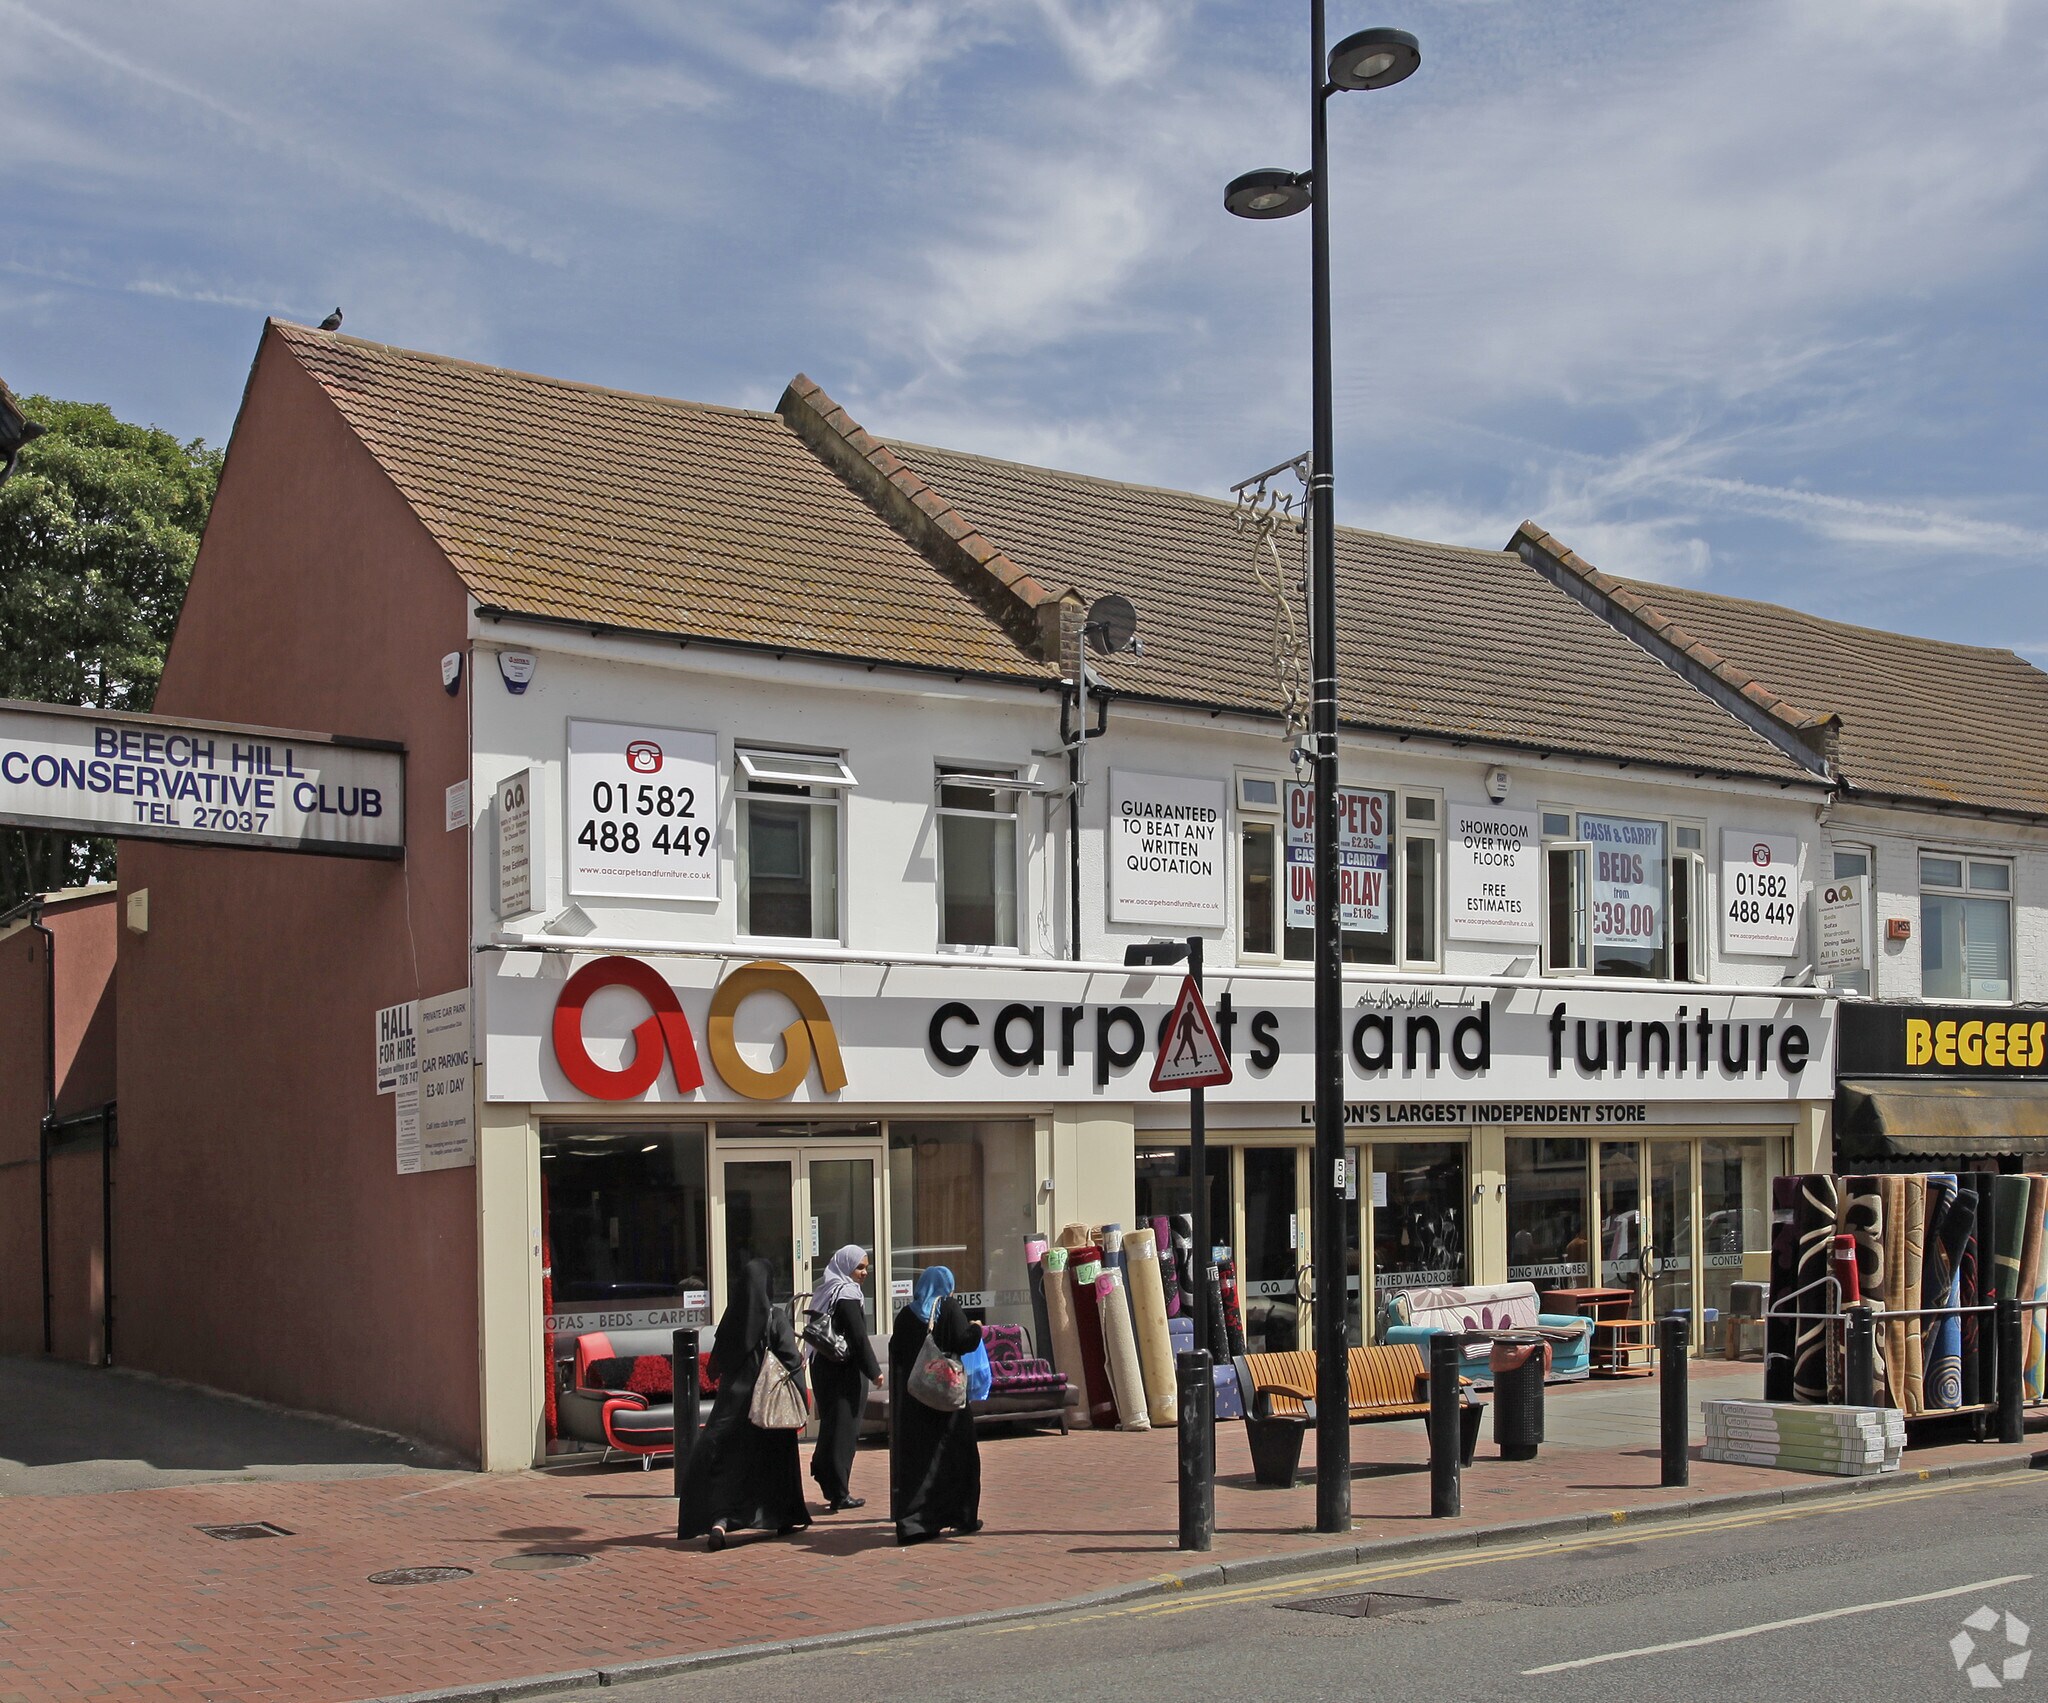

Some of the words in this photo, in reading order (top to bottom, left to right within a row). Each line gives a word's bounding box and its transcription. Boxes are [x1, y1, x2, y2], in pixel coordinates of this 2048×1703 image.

[95, 727, 214, 769] BEECH
[233, 743, 304, 779] HILL
[1, 751, 276, 808] CONSERVATIVE
[293, 782, 382, 817] CLUB
[593, 781, 695, 819] 01582
[133, 801, 179, 826] TEL
[193, 807, 269, 833] 27037
[1121, 800, 1217, 823] GUARANTEED
[1292, 788, 1382, 836] CAPETS
[1123, 819, 1142, 834] TO
[1147, 821, 1180, 838] BEAT
[1185, 825, 1214, 840] ANY
[1460, 819, 1528, 838] SHOWROOM
[1583, 821, 1612, 842] CASH
[1613, 828, 1622, 843] &
[1622, 826, 1658, 845] CARRY
[578, 820, 640, 854] 488
[652, 824, 711, 858] 449
[1141, 838, 1198, 857] WRITTEN
[1352, 836, 1374, 849] £2.35
[1464, 836, 1493, 850] OVER
[1497, 838, 1521, 852] TWO
[1295, 848, 1315, 862] CAS
[1346, 853, 1379, 867] CARRY
[1473, 852, 1515, 867] FLOORS
[579, 866, 711, 880] www.aacarpetsandfurniture.co.uk
[1127, 855, 1212, 876] QUOTATION
[1599, 851, 1644, 884] BEDS
[1291, 866, 1382, 907] UNRLAY
[1483, 883, 1506, 897] FREE
[1613, 887, 1630, 899] from
[1736, 872, 1787, 898] 01582
[1119, 898, 1219, 909] www.aacarpetsandfurniture.co.uk
[1353, 908, 1372, 919] £1.18
[1467, 898, 1522, 913] ESTIMATES
[1729, 899, 1760, 924] 488
[1765, 902, 1795, 925] 449
[1593, 901, 1654, 937] £39.00
[1820, 951, 1830, 959] All
[1840, 946, 1861, 956] Stock
[1824, 939, 1840, 947] Dining
[423, 1009, 441, 1022] PRIVATE
[442, 1006, 453, 1017] CAR
[453, 1003, 466, 1014] PARK
[381, 1005, 412, 1042] HALL
[1352, 1001, 1490, 1070] and
[1549, 1002, 1809, 1074] furniture
[1906, 1019, 2045, 1067] BEGEES
[380, 1043, 395, 1064] FOR
[397, 1037, 416, 1060] HIRE
[422, 1057, 437, 1073] CAR
[438, 1051, 469, 1070] PARKING
[449, 1078, 465, 1094] DAY
[1301, 1104, 1380, 1123] LN'S
[1386, 1104, 1466, 1122] LARGEST
[1472, 1104, 1590, 1122] INDEPENDENT
[1595, 1104, 1645, 1122] STORE
[1509, 1266, 1532, 1278] DING
[1534, 1263, 1586, 1277] WARDROBES
[1711, 1256, 1743, 1266] CONTEM
[957, 1293, 982, 1306] BLES
[545, 1315, 584, 1330] OFAS
[600, 1313, 633, 1327] BEDS
[648, 1309, 706, 1325] CARPETS
